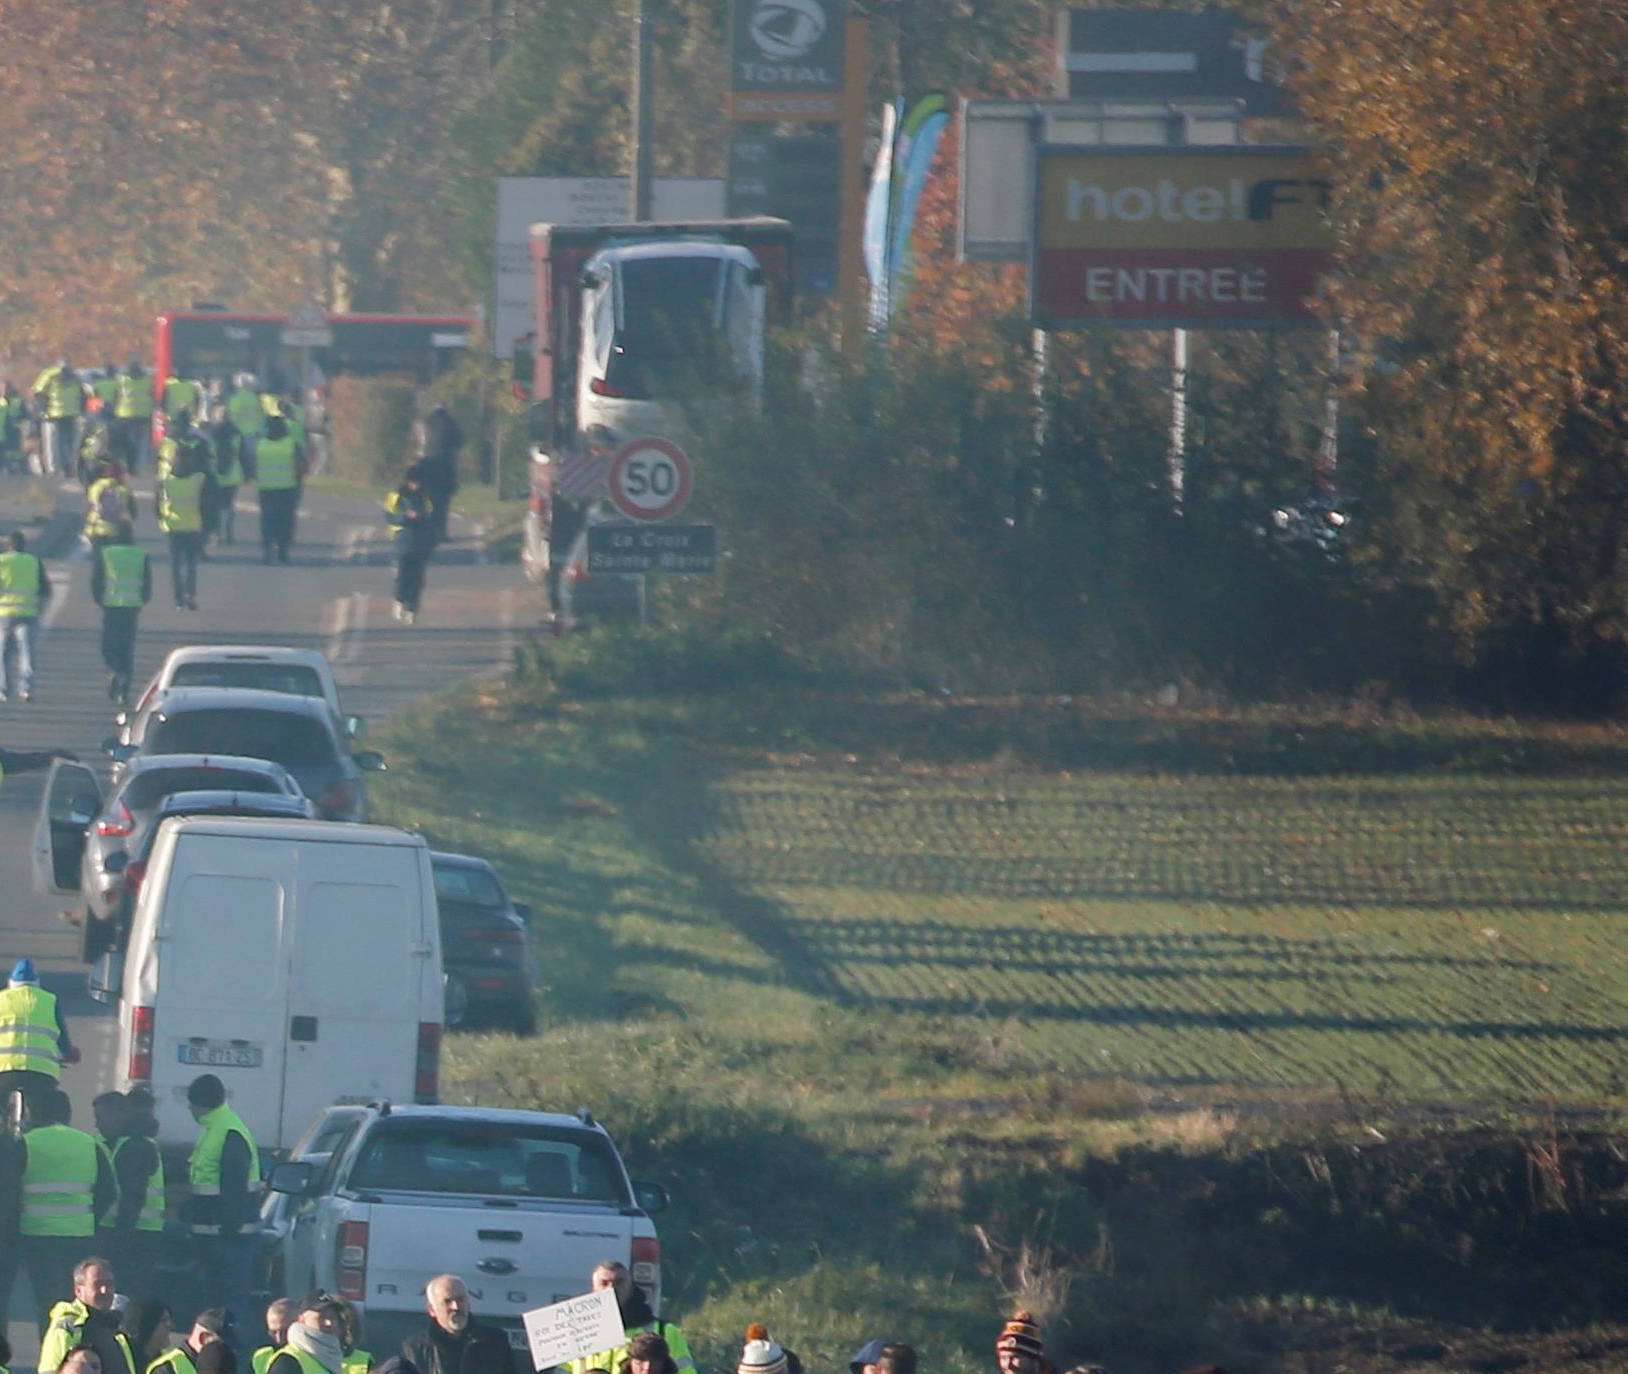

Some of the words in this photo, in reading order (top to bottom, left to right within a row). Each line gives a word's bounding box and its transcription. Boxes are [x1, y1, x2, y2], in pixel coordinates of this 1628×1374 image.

[737, 62, 836, 82] TOTAL
[627, 462, 673, 496] 50
[640, 532, 690, 548] Croix
[555, 1296, 603, 1321] MACRON
